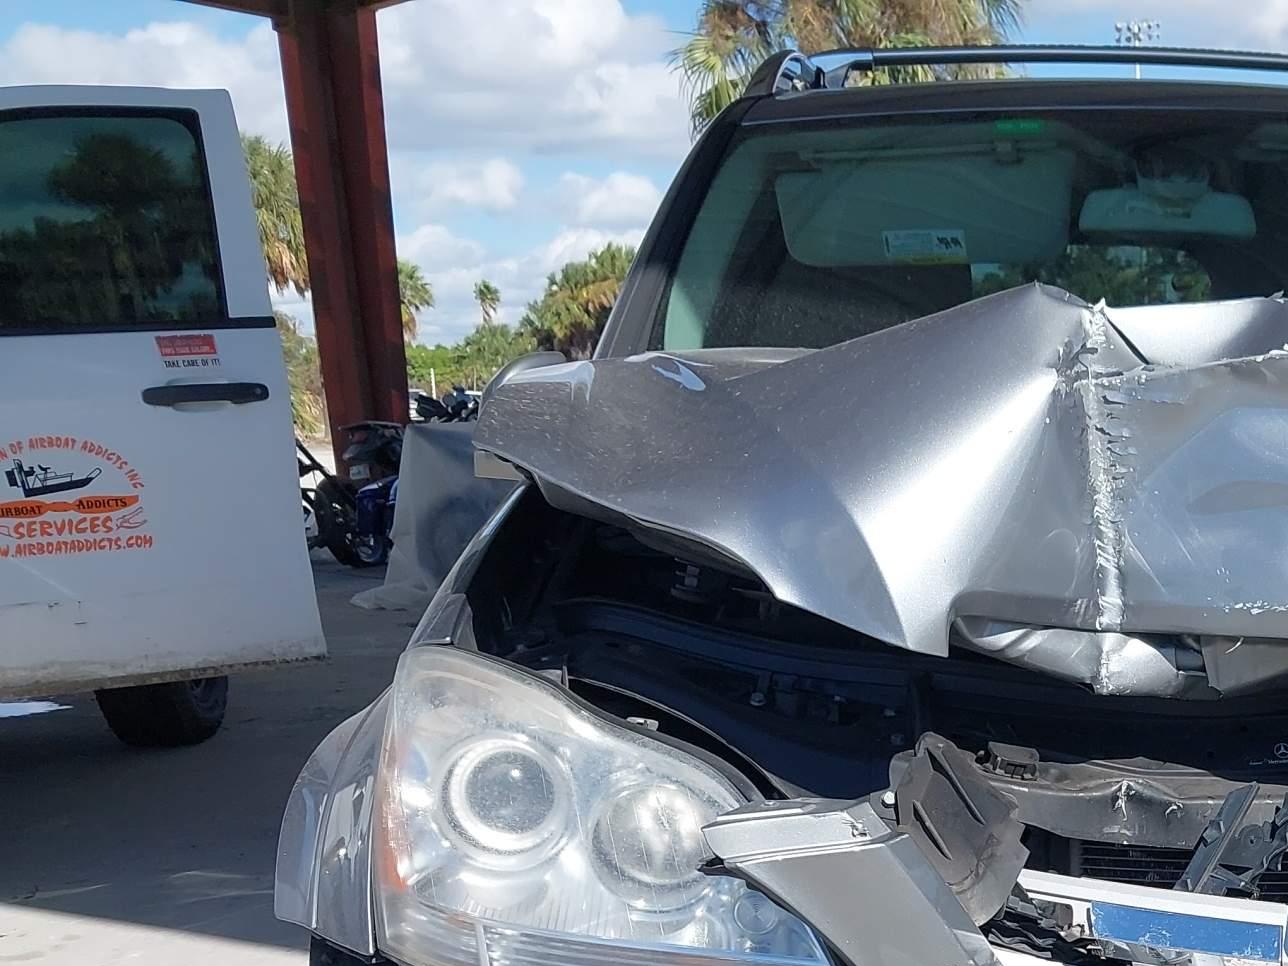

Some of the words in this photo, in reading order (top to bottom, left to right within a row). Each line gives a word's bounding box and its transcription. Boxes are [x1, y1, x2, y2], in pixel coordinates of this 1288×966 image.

[9, 441, 24, 455] OF
[28, 436, 77, 450] AIRBOAT
[80, 440, 128, 471] ADDICTS
[125, 468, 145, 489] INC
[0, 505, 43, 517] IRBOAT
[77, 498, 128, 510] ADDICTS
[13, 515, 114, 539] SERVICES
